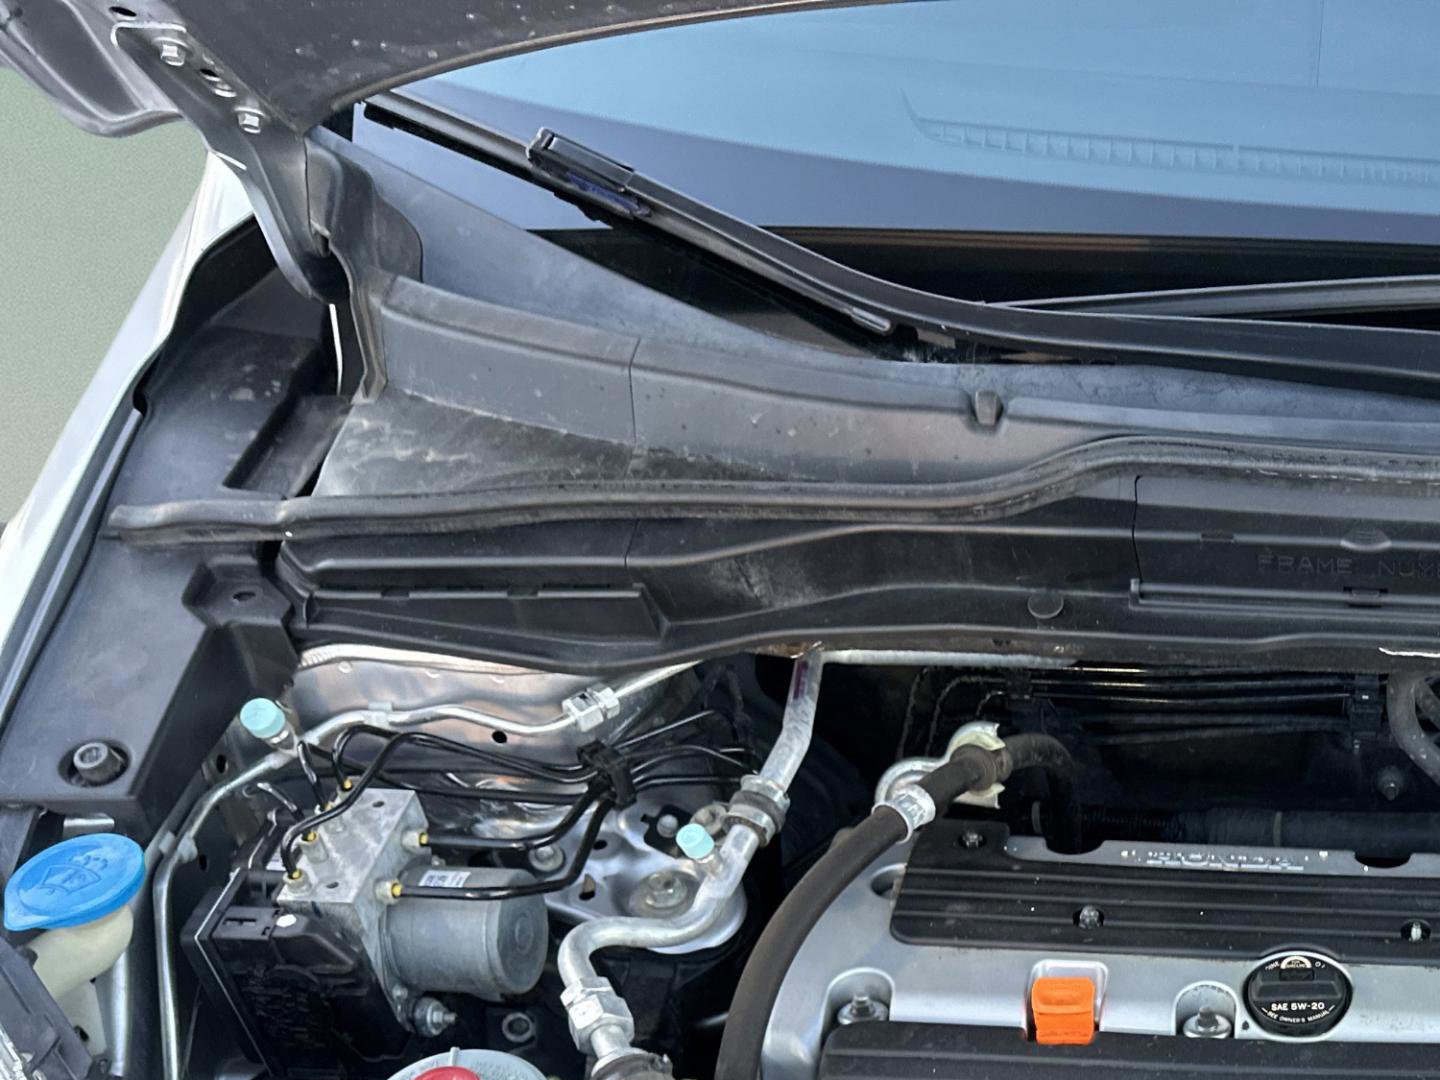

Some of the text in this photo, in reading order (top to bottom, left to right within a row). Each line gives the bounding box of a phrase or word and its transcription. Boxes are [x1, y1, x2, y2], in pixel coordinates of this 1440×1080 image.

[1258, 554, 1353, 576] FRAME
[1271, 1002, 1325, 1011] SAE 5W-20
